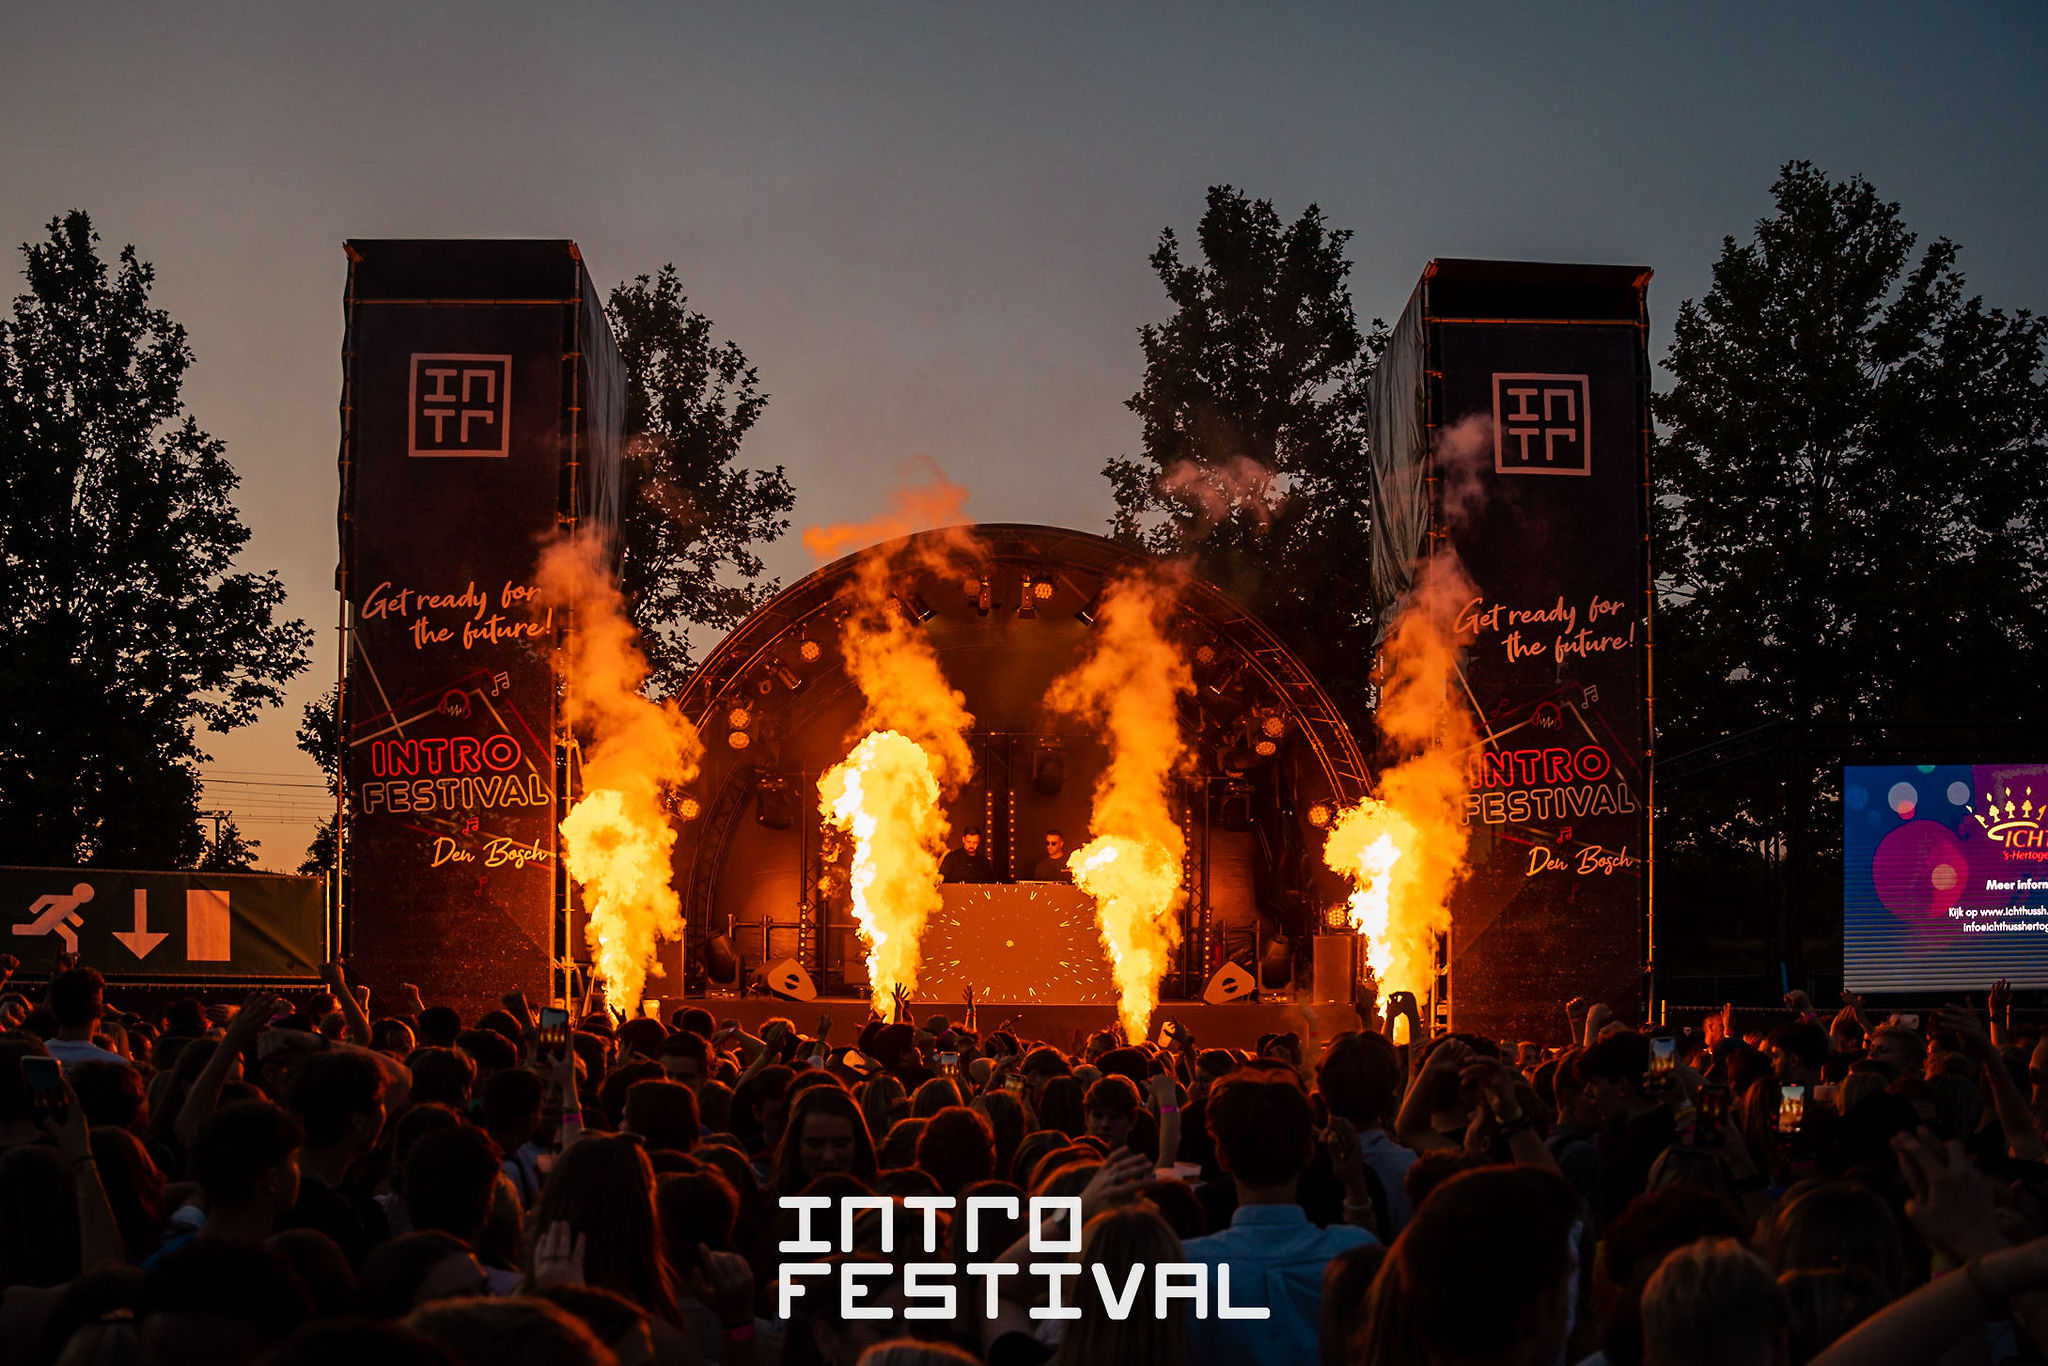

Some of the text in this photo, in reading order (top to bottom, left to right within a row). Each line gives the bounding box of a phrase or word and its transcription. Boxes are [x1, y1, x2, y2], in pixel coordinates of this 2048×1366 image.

[361, 580, 542, 620] Get ready for
[1454, 595, 1625, 634] Get ready for
[409, 607, 553, 649] the future!
[1501, 622, 1635, 663] the future!
[371, 734, 522, 776] INTRO
[1468, 745, 1611, 789] INTRO
[362, 773, 550, 815] FESTIVAL
[1460, 782, 1635, 826] FESTIVAL
[431, 836, 549, 870] Den Bosch
[1526, 846, 1634, 877] Den Bosch
[1986, 879, 2016, 891] Meer
[1948, 906, 1964, 919] Kijk
[1965, 910, 1979, 919] op
